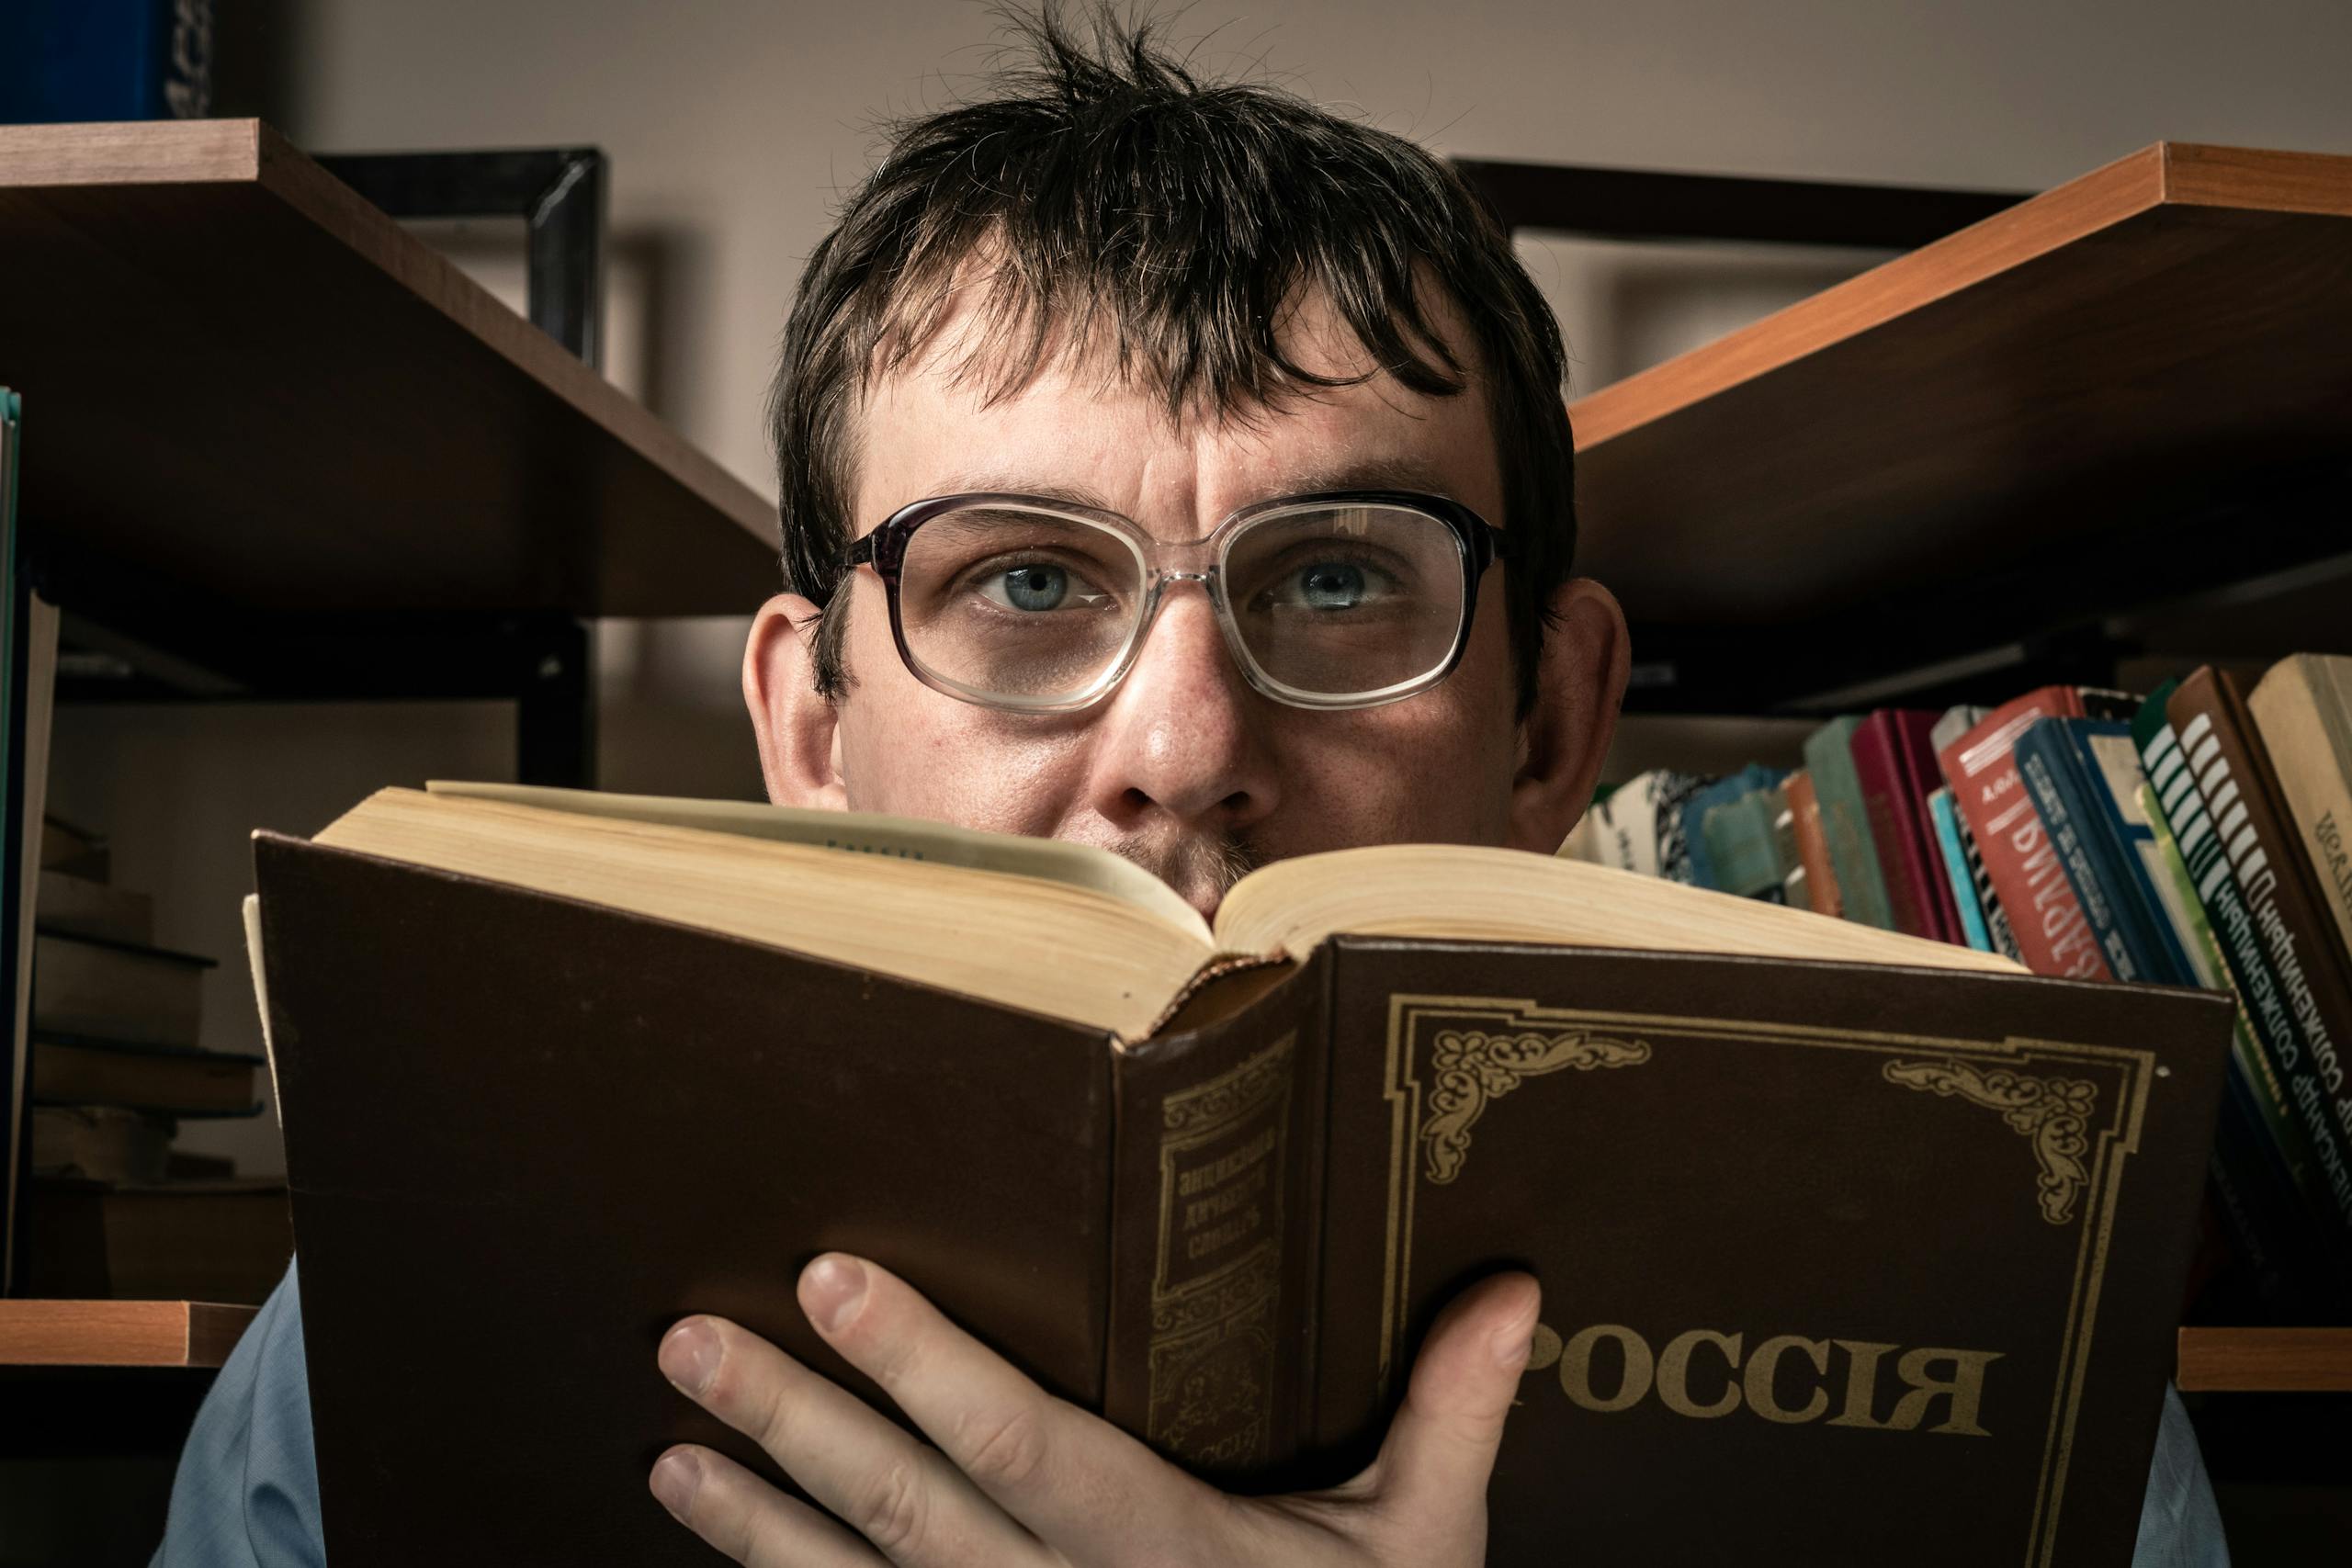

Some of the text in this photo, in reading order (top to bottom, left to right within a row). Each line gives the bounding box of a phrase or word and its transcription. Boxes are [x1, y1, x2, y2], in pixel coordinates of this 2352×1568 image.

[2215, 882, 2298, 1070] СОЛЖЕНИЦЫН
[2257, 899, 2343, 1093] СОЛЖЕНИЦЫН
[2292, 1075, 2352, 1224] ЛЕКСАНДР
